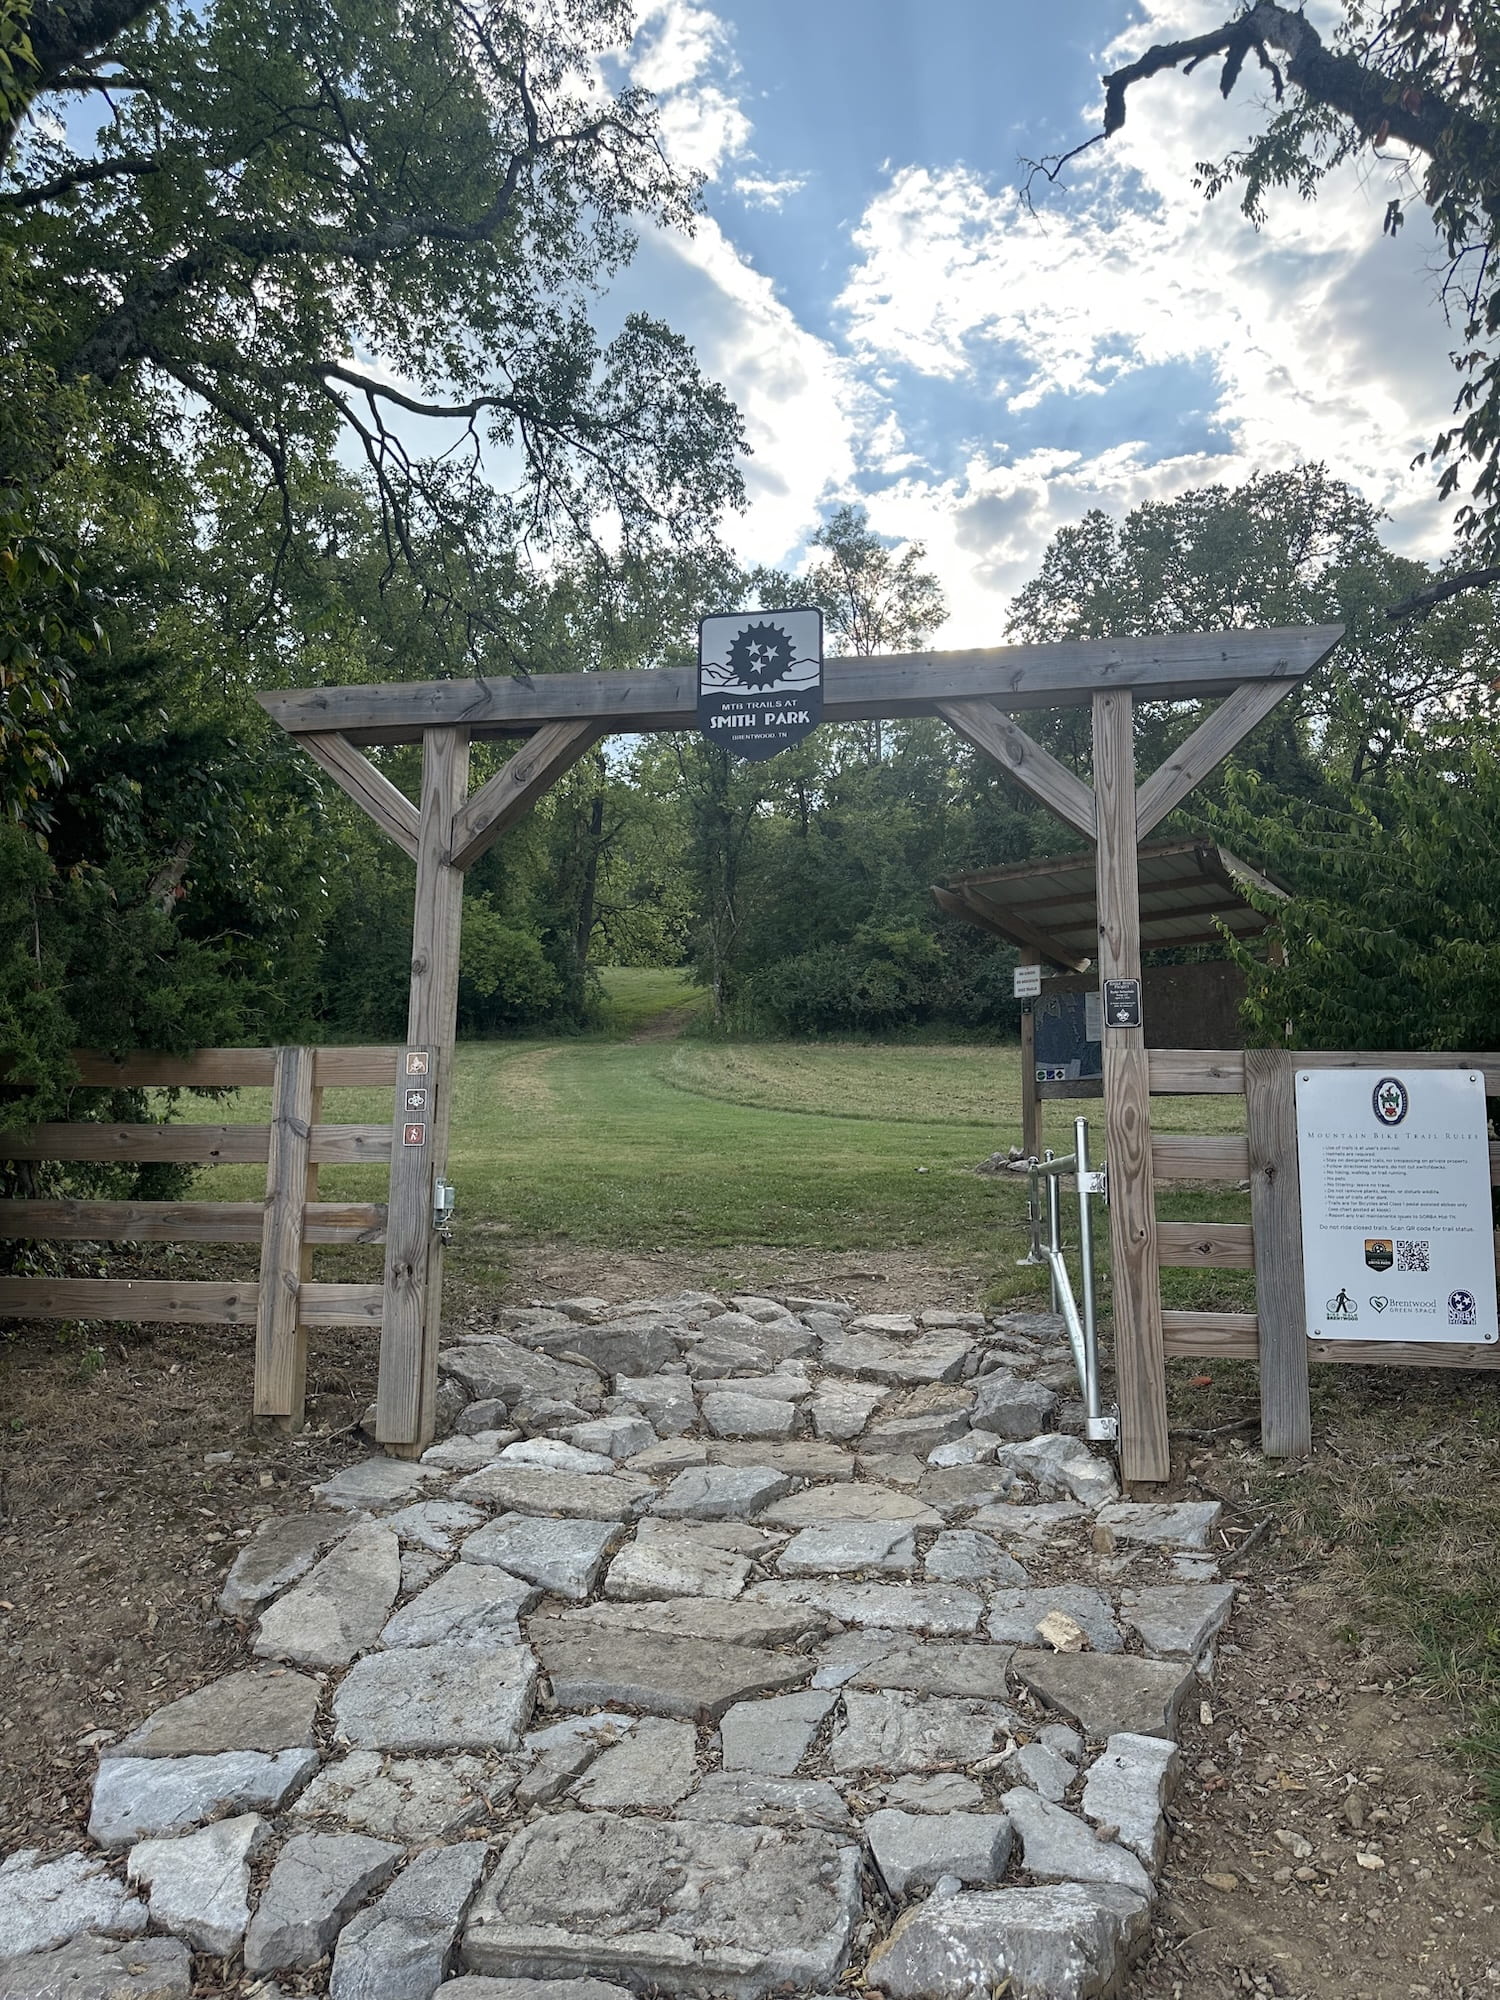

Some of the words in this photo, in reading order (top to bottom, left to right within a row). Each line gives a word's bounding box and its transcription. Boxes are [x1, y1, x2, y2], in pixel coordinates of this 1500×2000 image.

[722, 702, 743, 711] MTB
[747, 700, 782, 709] TRAILS
[710, 714, 755, 729] SMITH
[765, 711, 810, 726] PARK
[1390, 1298, 1437, 1308] Brentwood
